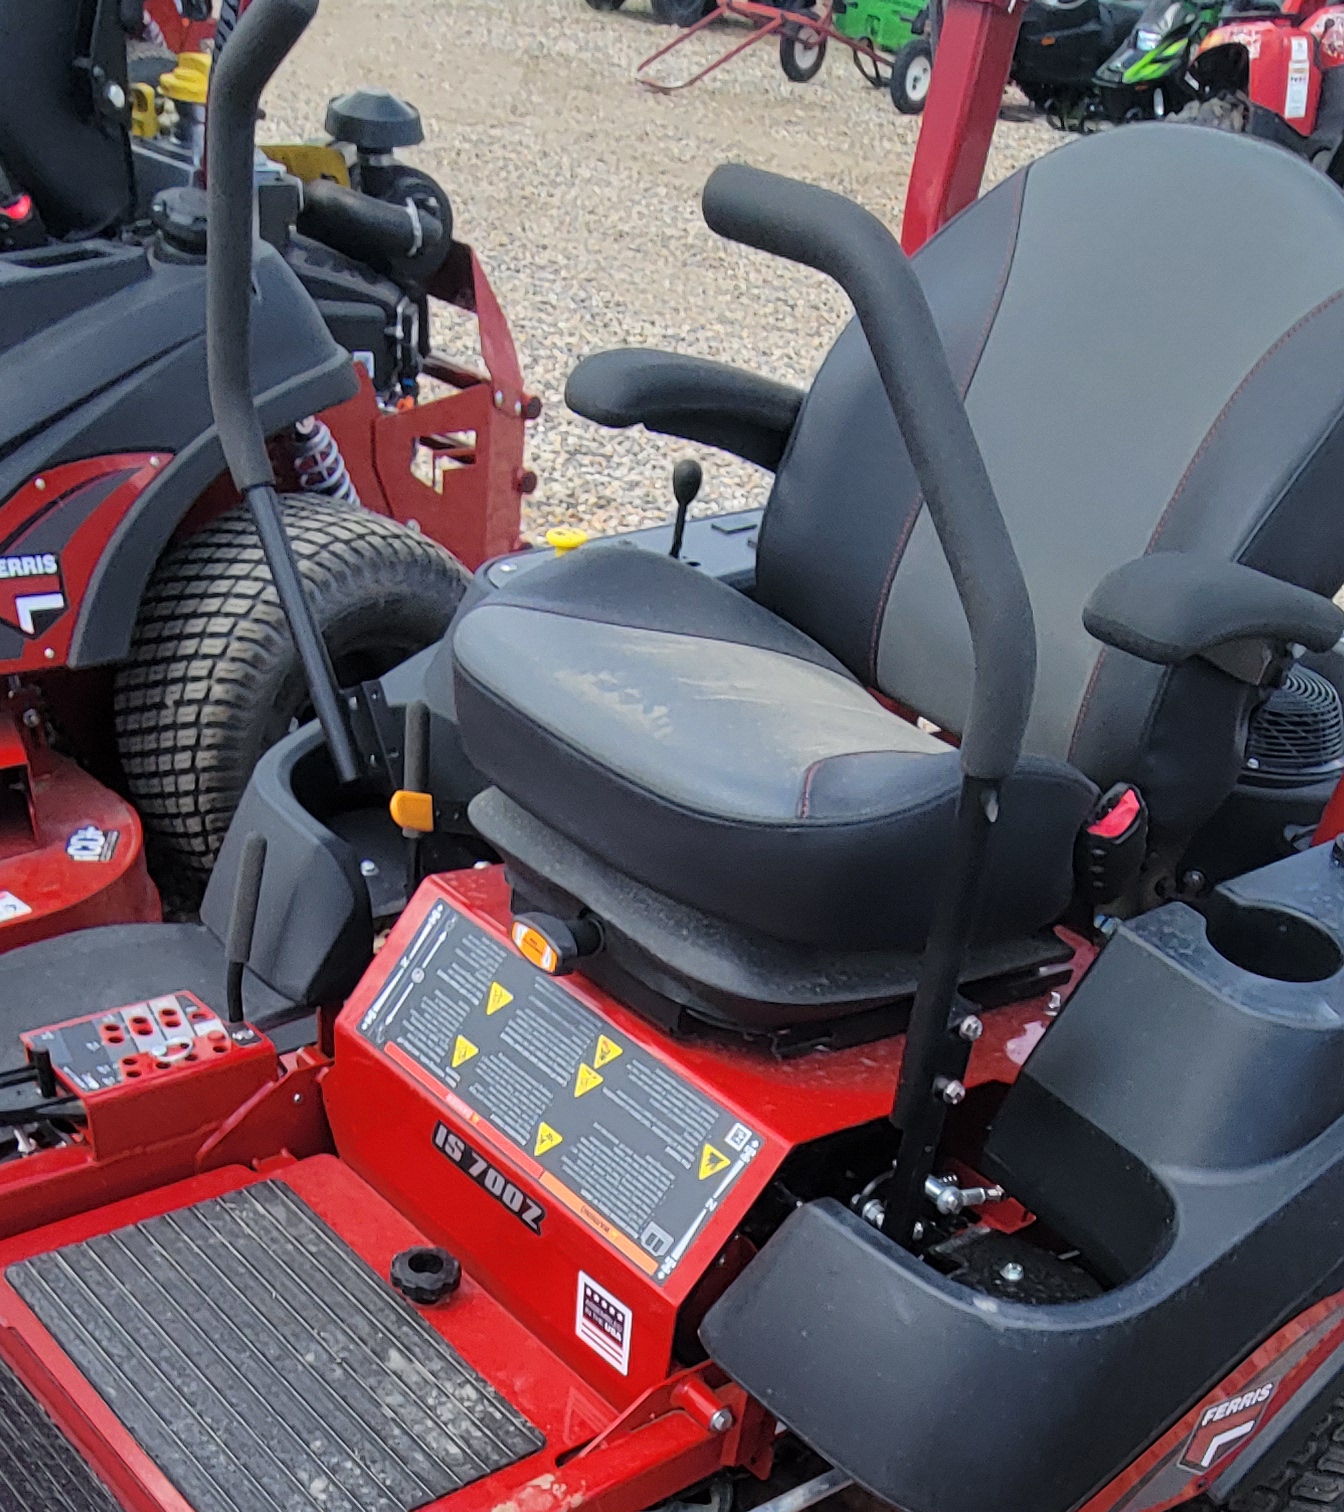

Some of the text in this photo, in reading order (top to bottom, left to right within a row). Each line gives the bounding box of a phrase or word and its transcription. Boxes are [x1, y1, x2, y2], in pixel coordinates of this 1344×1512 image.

[435, 1124, 543, 1231] IS 700Z
[1201, 1381, 1274, 1427] FERRIS
